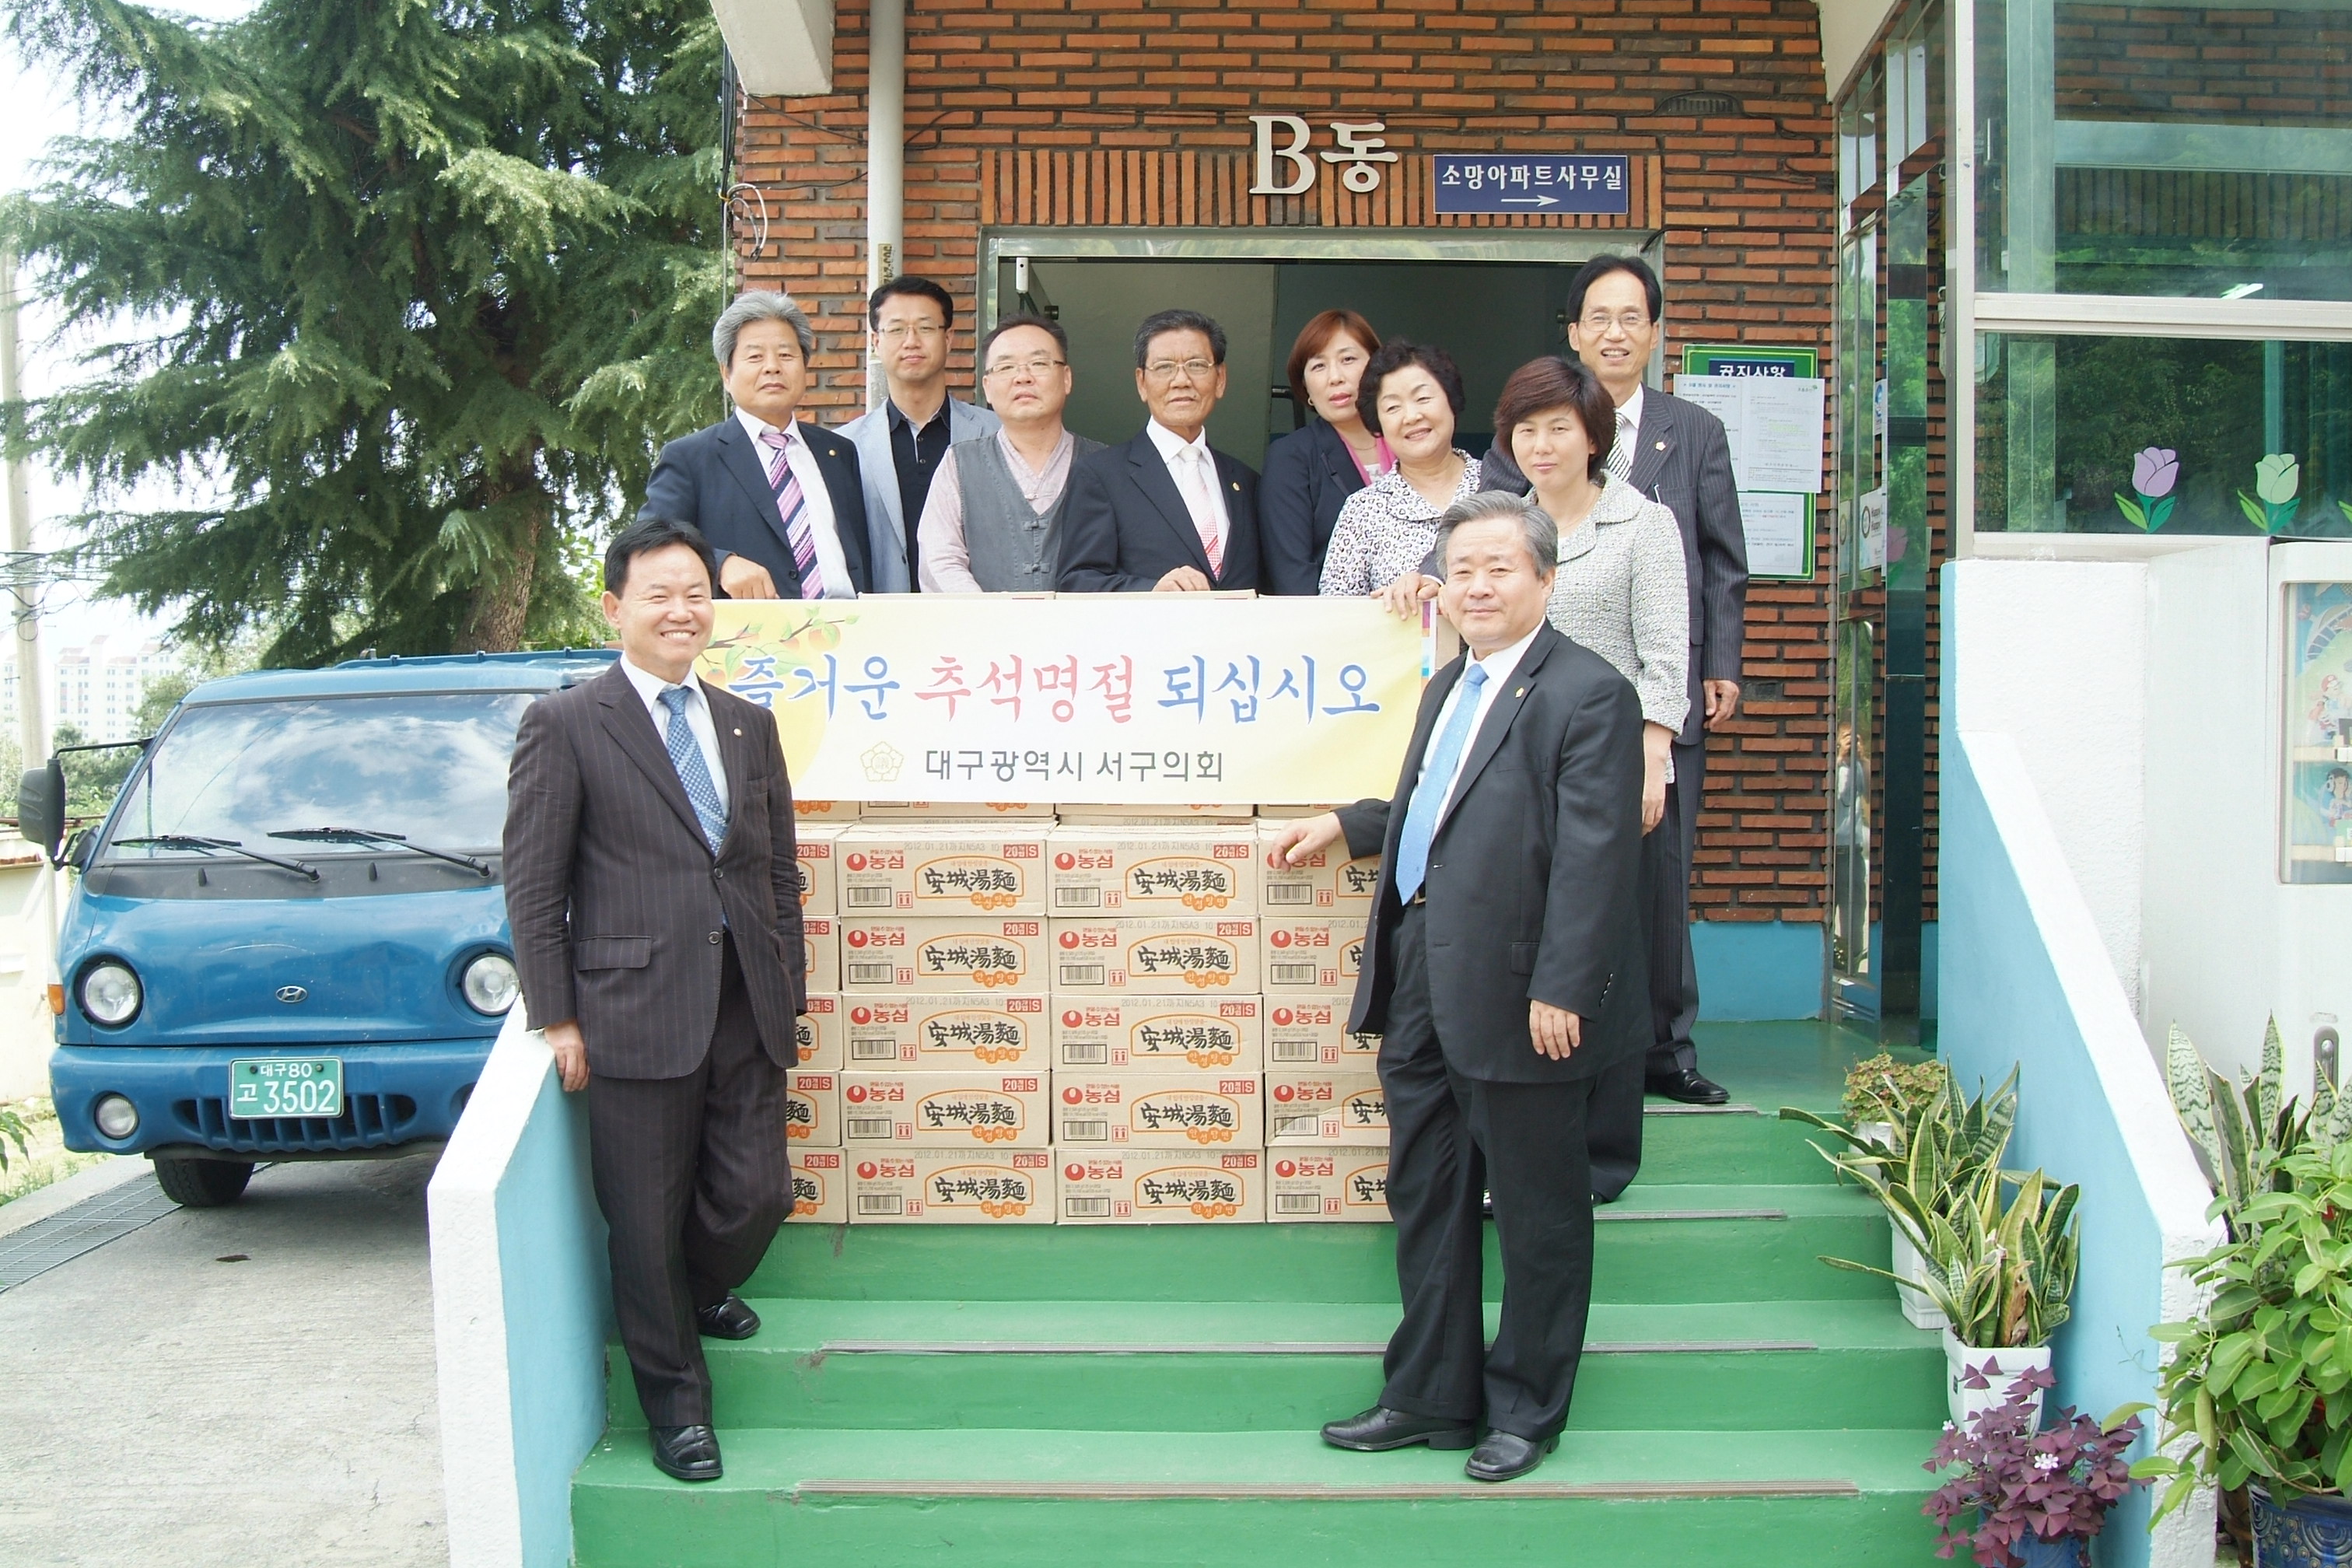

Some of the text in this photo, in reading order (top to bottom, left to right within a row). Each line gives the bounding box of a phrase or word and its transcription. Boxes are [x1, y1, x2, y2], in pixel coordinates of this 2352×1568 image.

[1248, 115, 1398, 194] B동
[1441, 164, 1622, 191] 소망아파트사무실
[728, 654, 1381, 725] 즐거운 추석명절 되십시오
[926, 749, 1083, 782] 대구광역시
[1097, 751, 1223, 782] 서구의회
[870, 856, 904, 870] 농심
[1078, 855, 1113, 869] 농심
[925, 868, 1017, 894] 安城湯麵
[1134, 868, 1227, 894] 安城湯麵
[870, 933, 905, 947] 농심
[1082, 933, 1117, 947] 농심
[1293, 933, 1329, 947] 농심
[925, 945, 1017, 971] 安城湯麵
[1138, 946, 1230, 972] 安城湯麵
[873, 1010, 908, 1024] 농심
[1085, 1013, 1120, 1027] 농심
[1296, 1010, 1331, 1024] 농심
[928, 1020, 1020, 1047] 安城湯麵
[1140, 1025, 1233, 1052] 安城湯麵
[260, 1062, 313, 1078] 대구80
[236, 1080, 336, 1113] 고 3502
[870, 1087, 904, 1101] 농심
[1085, 1090, 1120, 1103] 농심
[1297, 1087, 1332, 1101] 농심
[924, 1101, 1016, 1127] 安城湯麵
[1140, 1102, 1232, 1129] 安城湯麵
[880, 1164, 914, 1178] 농심
[1088, 1166, 1122, 1179] 농심
[1298, 1162, 1333, 1176] 농심
[935, 1177, 1026, 1202] 安城湯麵
[1143, 1179, 1235, 1204] 安城湯麵
